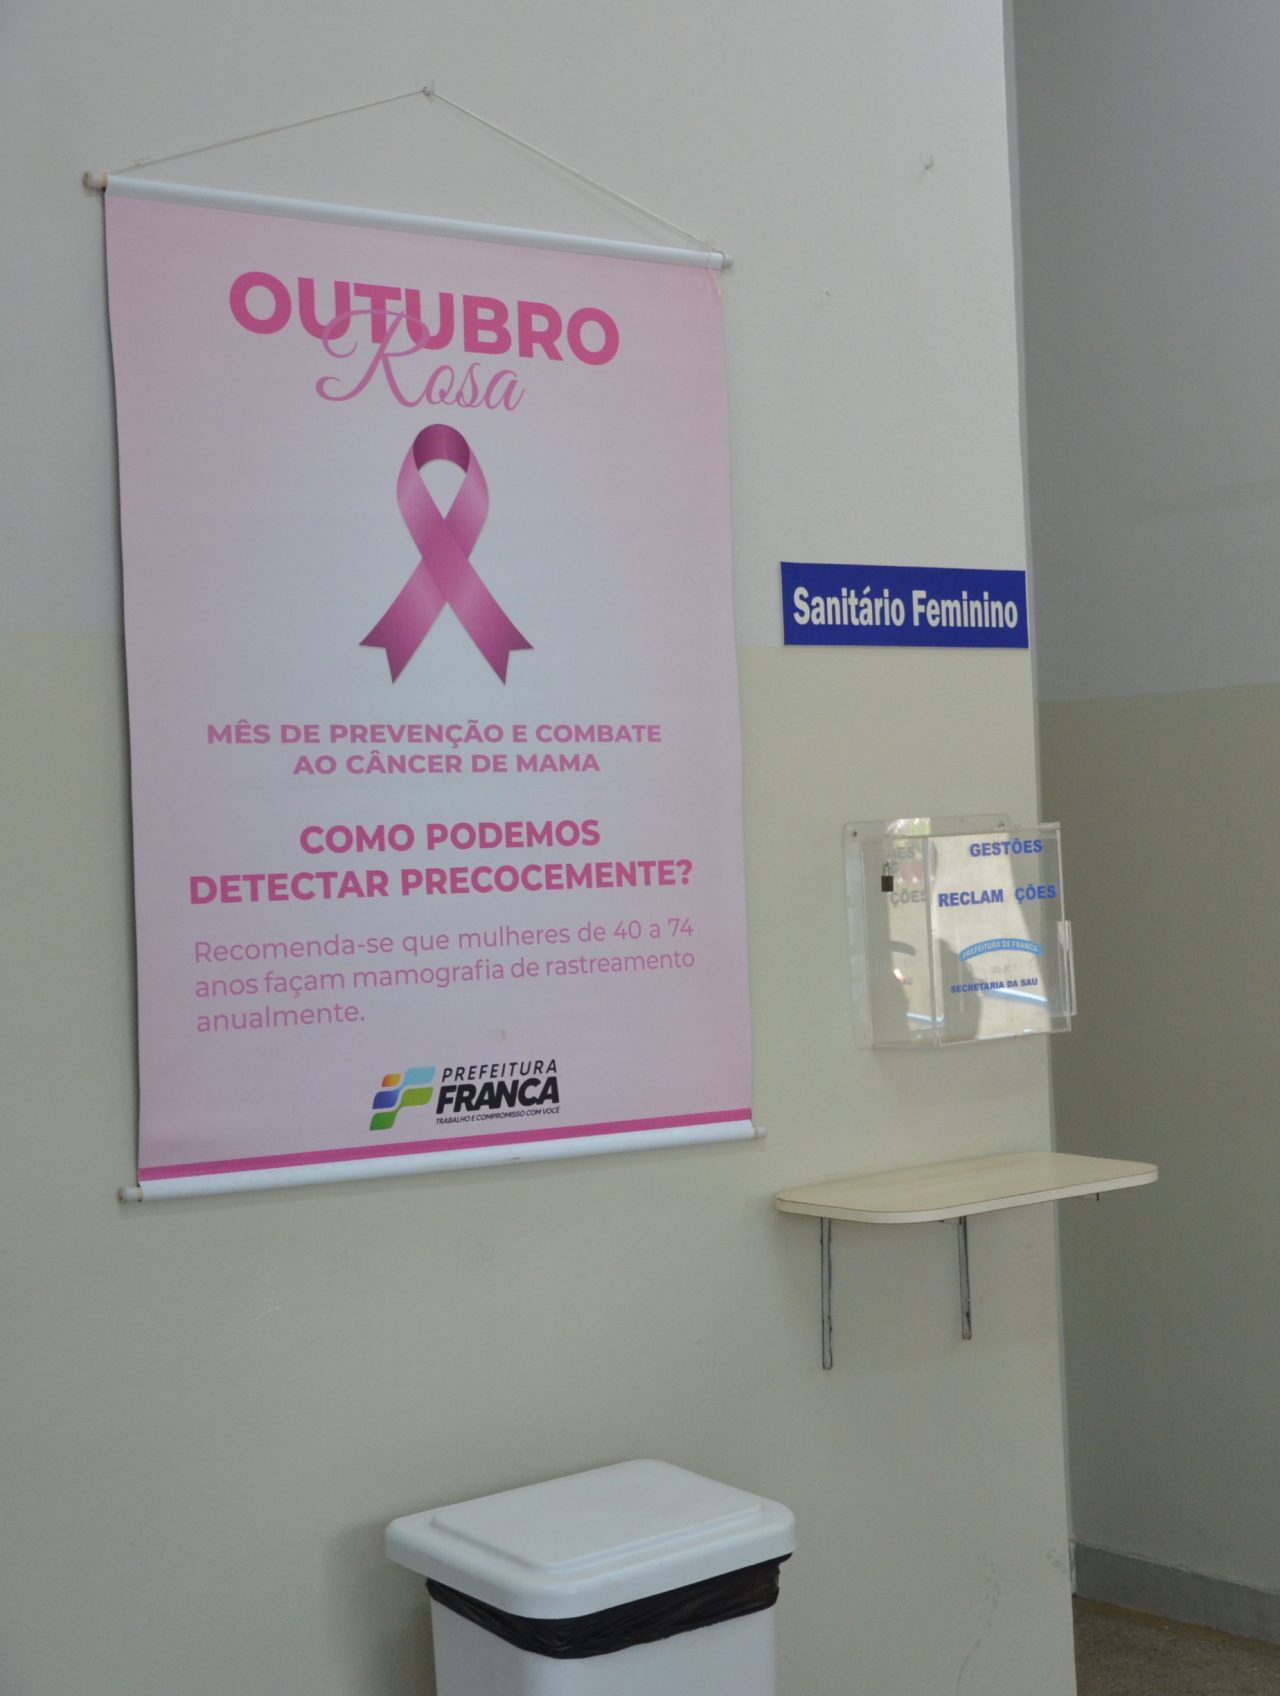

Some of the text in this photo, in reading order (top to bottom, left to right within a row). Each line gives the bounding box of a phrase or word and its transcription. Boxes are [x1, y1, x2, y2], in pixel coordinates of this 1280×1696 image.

[229, 271, 619, 365] OUTUBRO
[315, 309, 525, 411] Rosa
[793, 586, 1018, 629] Sanitário Feminino
[207, 719, 661, 749] MÊS DE PREVENÇÃO E COMBATE
[293, 750, 600, 775] AO CÂNCER DE MAMA
[300, 819, 600, 854] COMO PODEMOS
[970, 838, 1043, 857] GESTÕES
[189, 859, 692, 904] DETECTAR PRECOCEMENTE?
[938, 884, 1057, 907] RECLAM ÇÕES
[194, 917, 694, 963] Recomenda-se que mulheres de 40 a 74
[195, 950, 695, 998] anos façam mamografia de rastreamento
[951, 981, 1004, 993] SECRETARIA
[1007, 980, 1018, 988] DA
[197, 1003, 365, 1032] anualmente.
[442, 1059, 557, 1082] PREFEITURA
[436, 1076, 560, 1114] FRANCA
[436, 1115, 471, 1125] TRABALHO
[475, 1110, 525, 1122] COMPROMISSO
